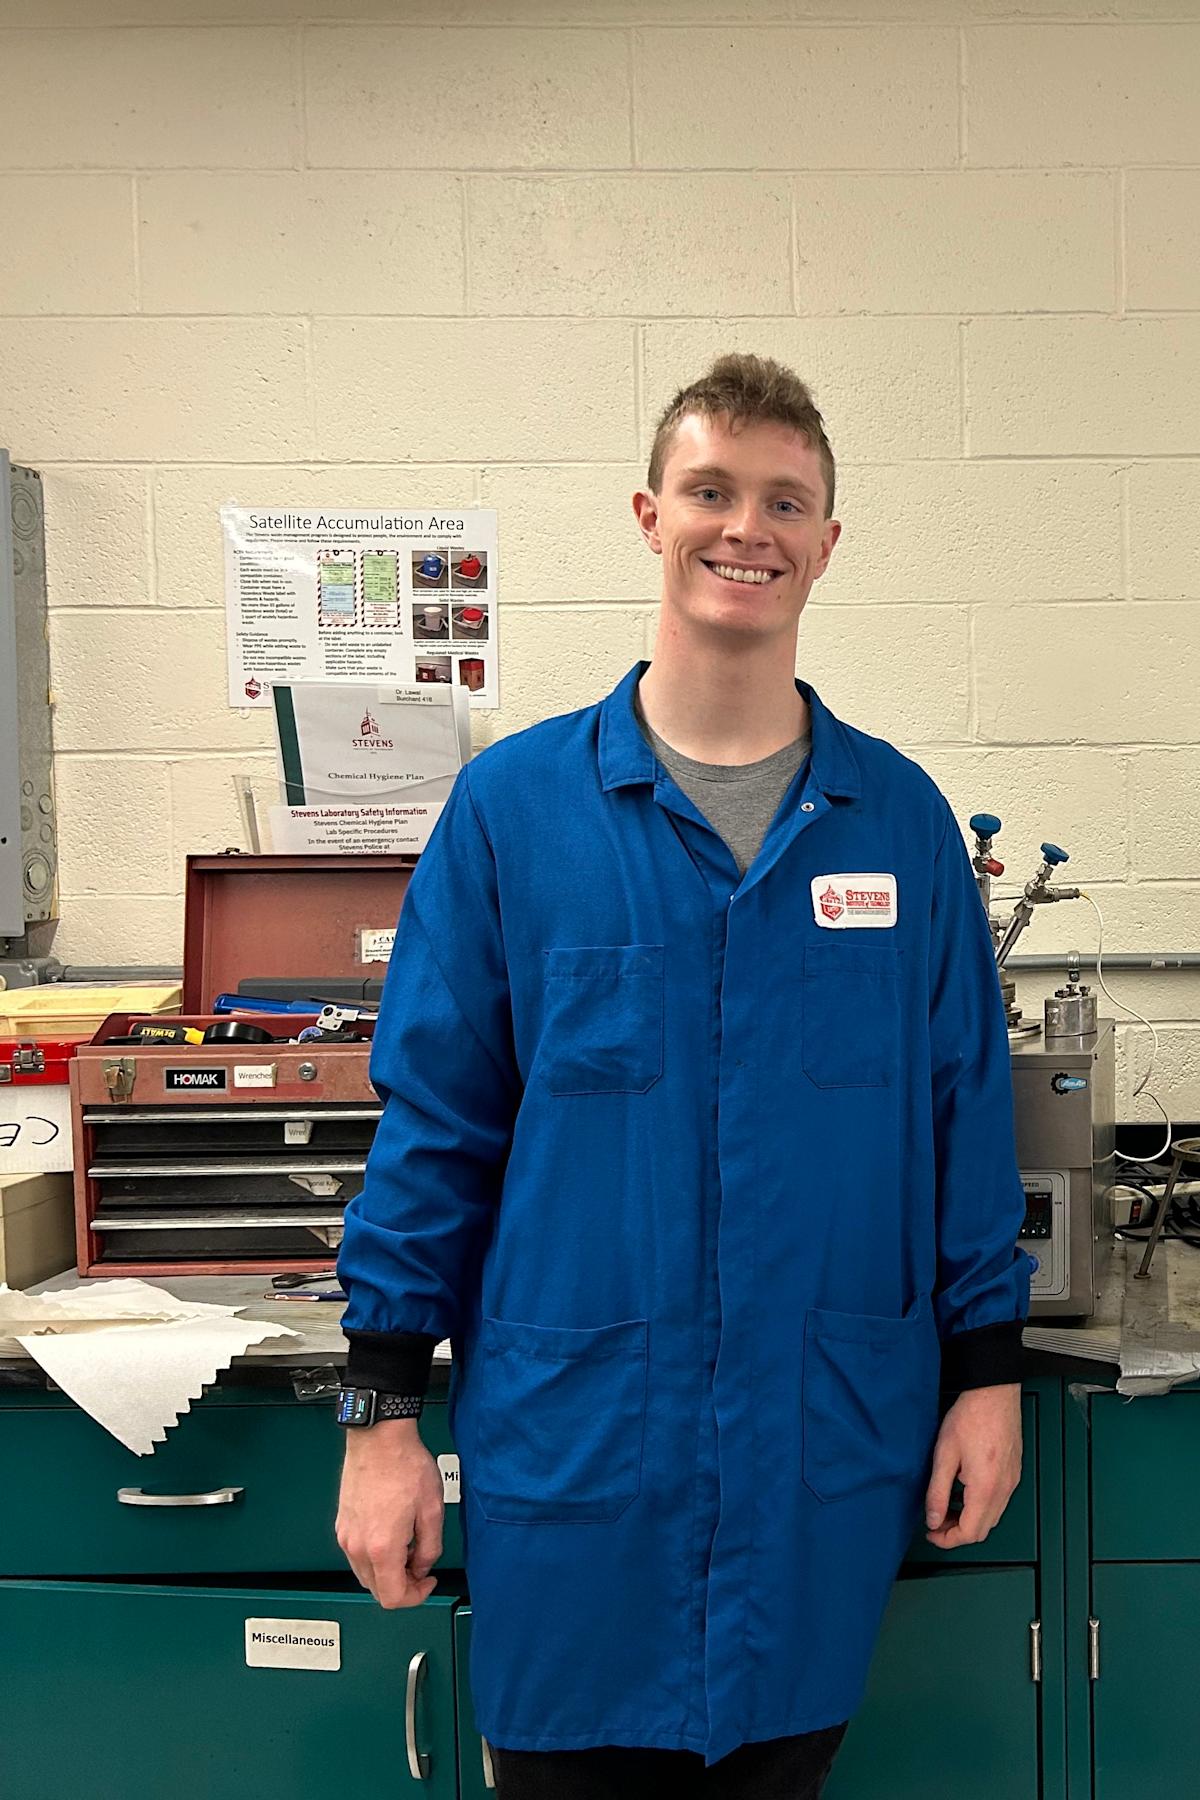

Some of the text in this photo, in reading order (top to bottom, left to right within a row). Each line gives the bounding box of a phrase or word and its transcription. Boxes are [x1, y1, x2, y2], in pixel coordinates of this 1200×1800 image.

[250, 514, 464, 530] Satellite Accumulation Area
[352, 740, 393, 748] STEVENS
[328, 772, 367, 780] Chemical
[369, 773, 403, 781] Hygiene
[291, 807, 427, 818] Stevens Laboratory Safety Information
[845, 890, 890, 900] STEVENS
[174, 1073, 218, 1085] HOMAK
[444, 1472, 458, 1481] Mi
[252, 1633, 335, 1646] Miscellaneous
